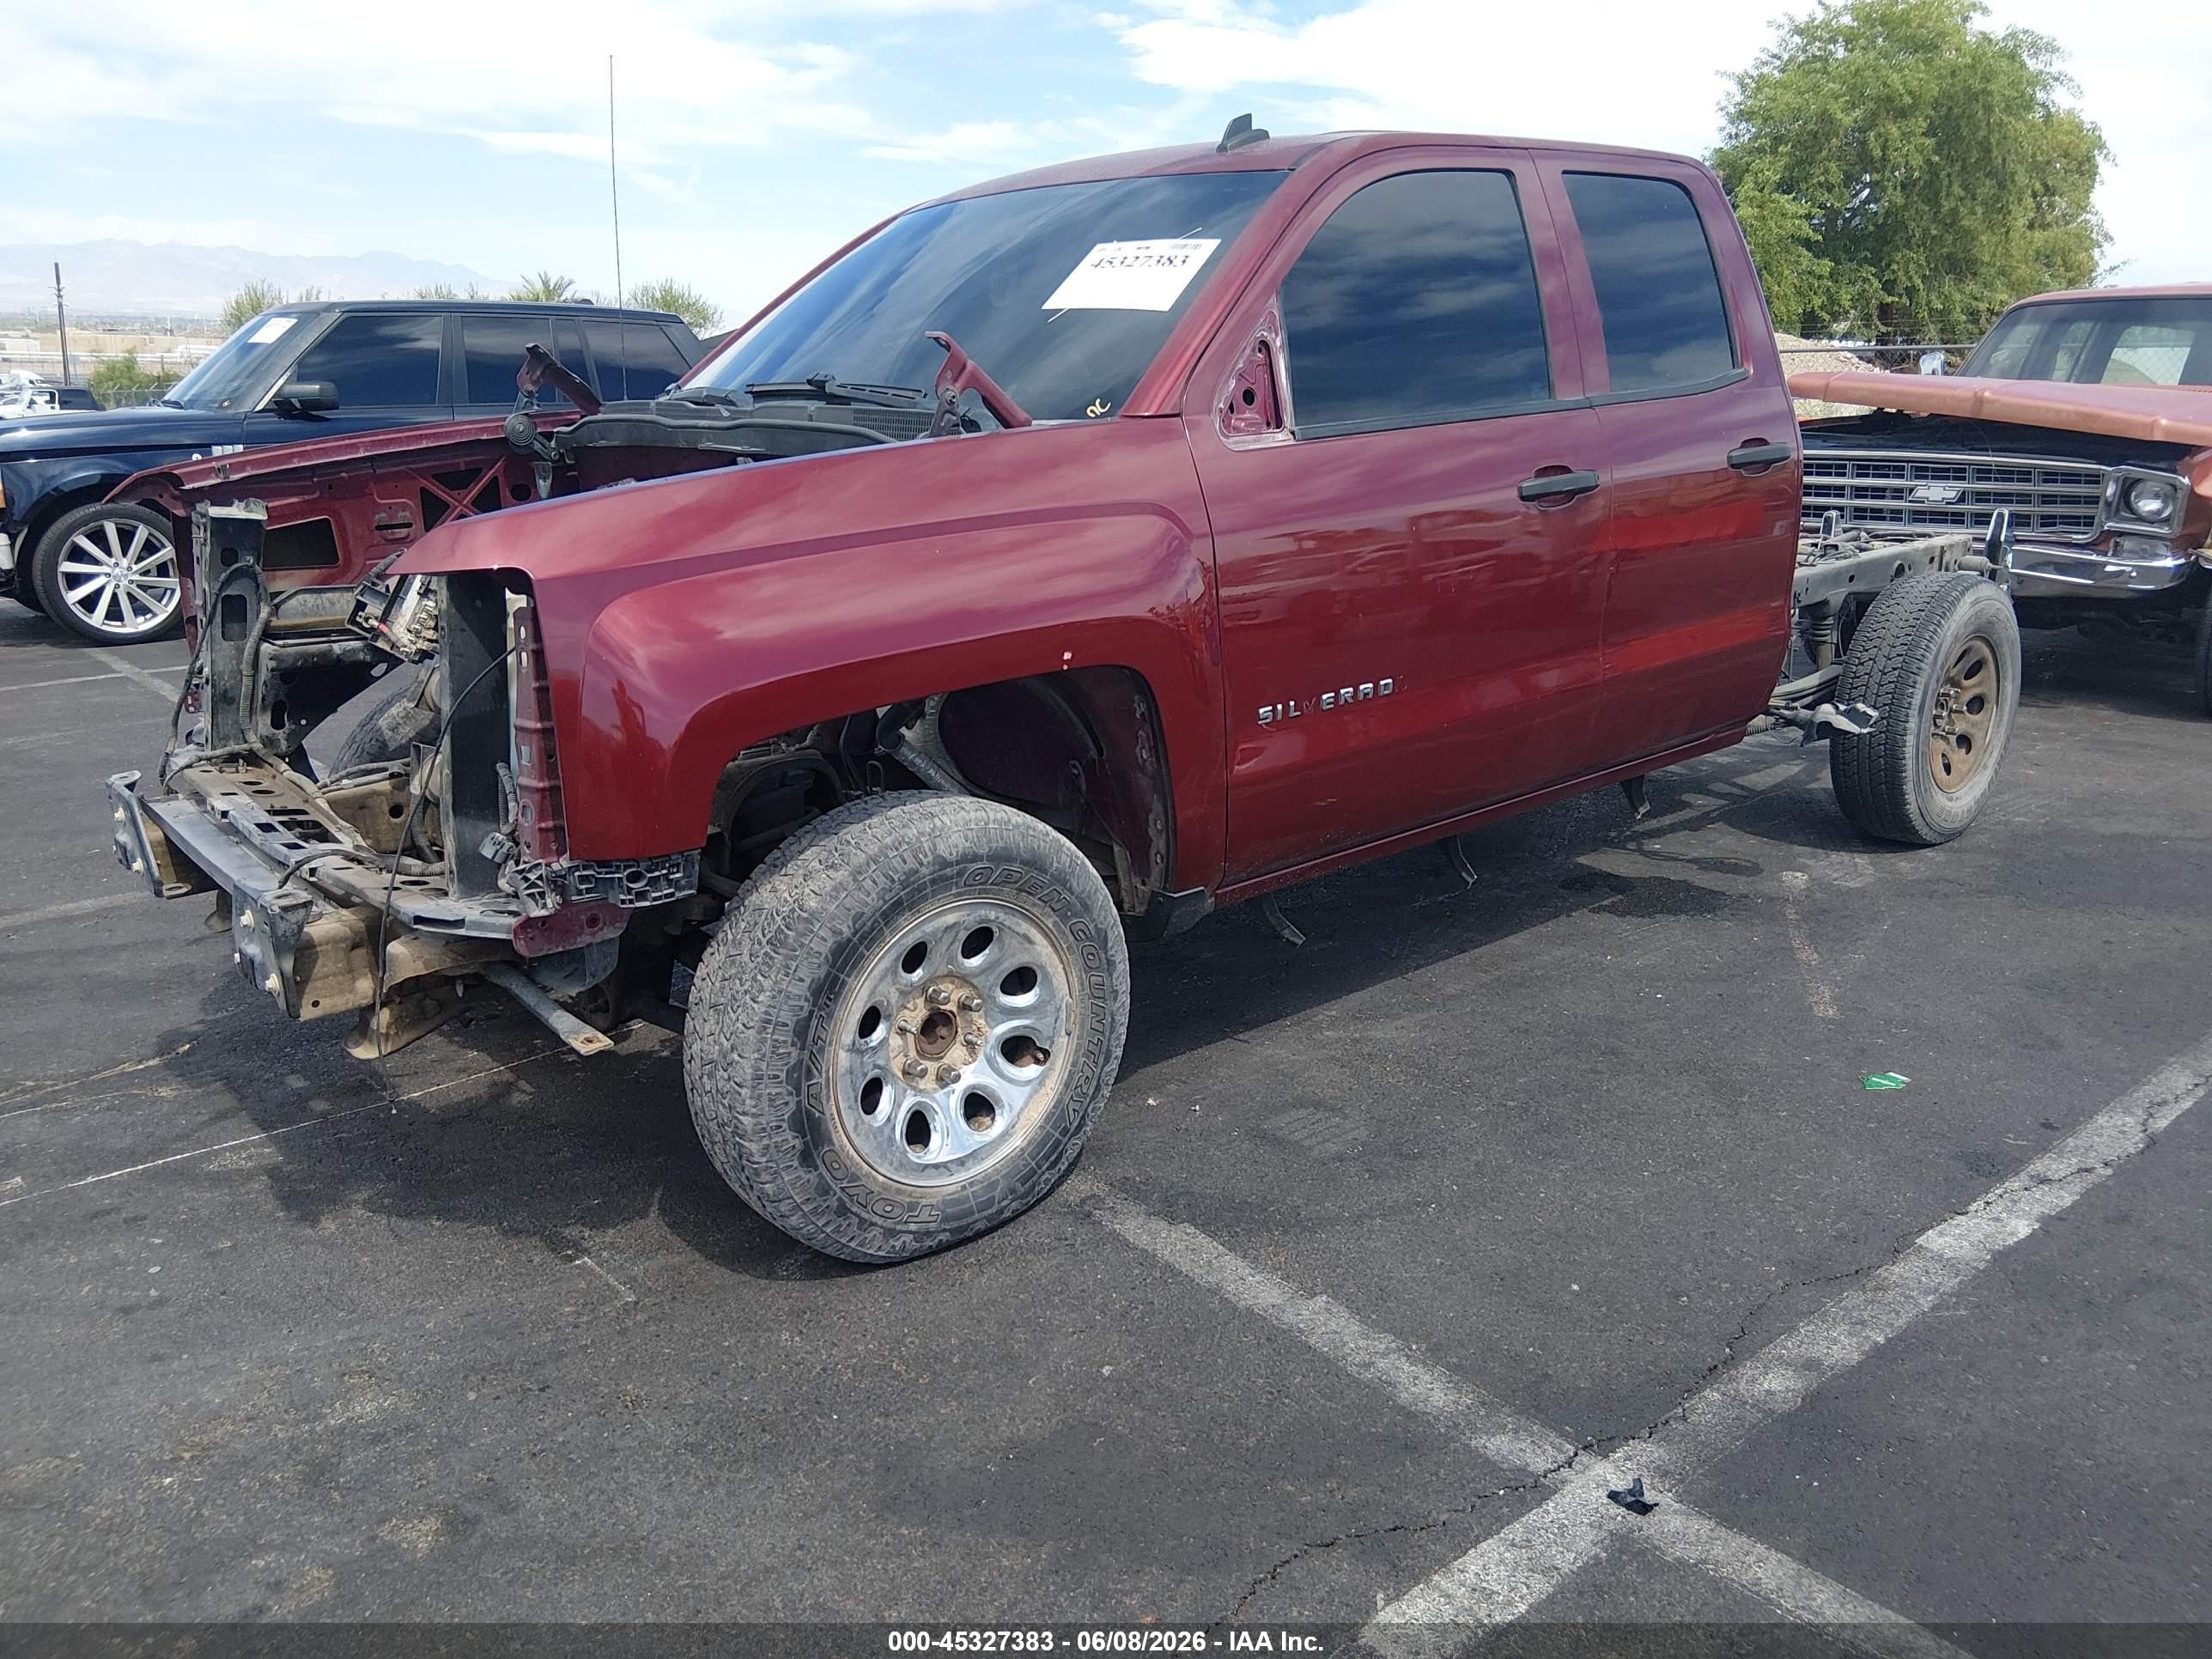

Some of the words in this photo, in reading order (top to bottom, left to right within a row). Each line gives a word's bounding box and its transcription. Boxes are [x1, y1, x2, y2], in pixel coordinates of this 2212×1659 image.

[1091, 254, 1191, 269] 45327383
[963, 864, 1072, 914] OPEN
[1066, 919, 1109, 1127] COUNTRY
[821, 1147, 942, 1225] TOYO
